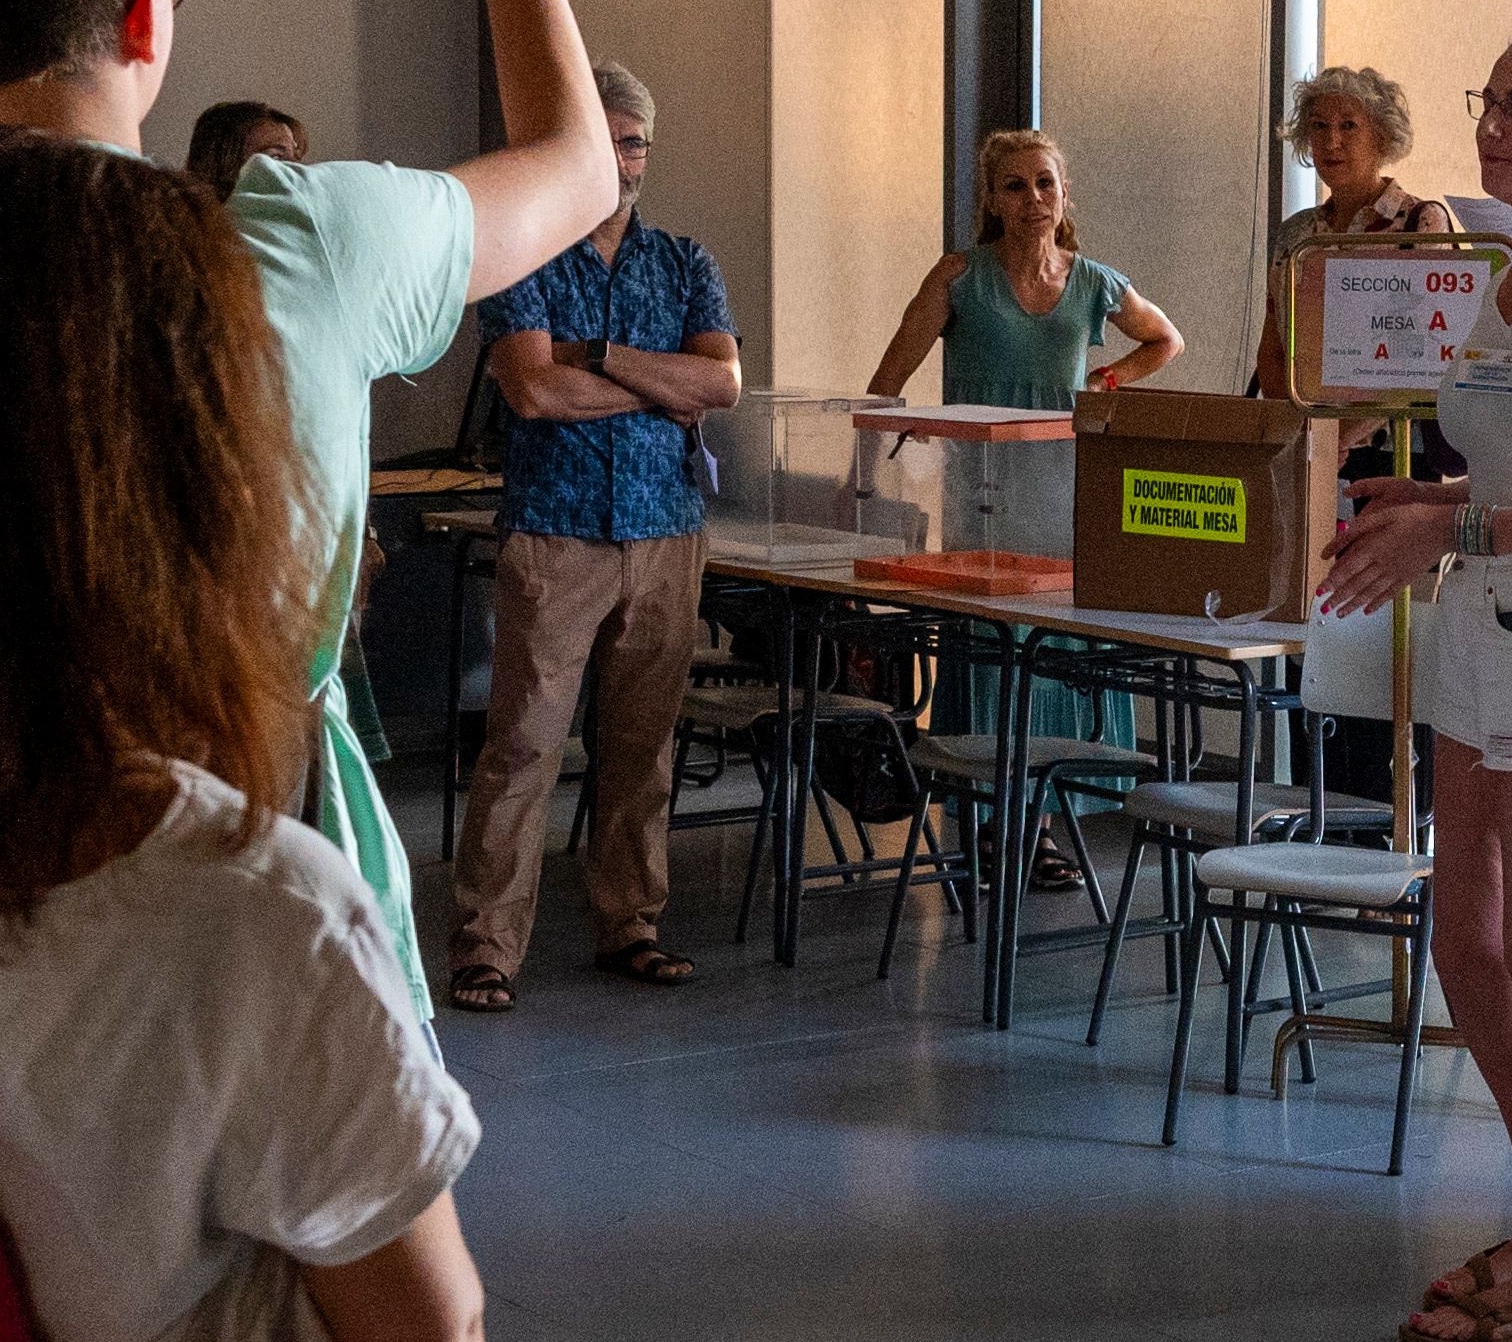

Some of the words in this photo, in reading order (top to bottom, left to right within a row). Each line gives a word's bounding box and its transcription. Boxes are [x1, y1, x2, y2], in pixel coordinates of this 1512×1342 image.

[1340, 275, 1411, 292] SECCIÓN
[1425, 272, 1475, 294] 093
[1370, 315, 1415, 331] MESA
[1428, 310, 1448, 331] A
[1374, 343, 1389, 360] A
[1440, 344, 1455, 361] K
[1133, 478, 1236, 506] DOCUMENTACIÓN
[1129, 504, 1137, 523] Y
[1140, 505, 1200, 530] MATERIAL
[1203, 511, 1238, 533] MESA
